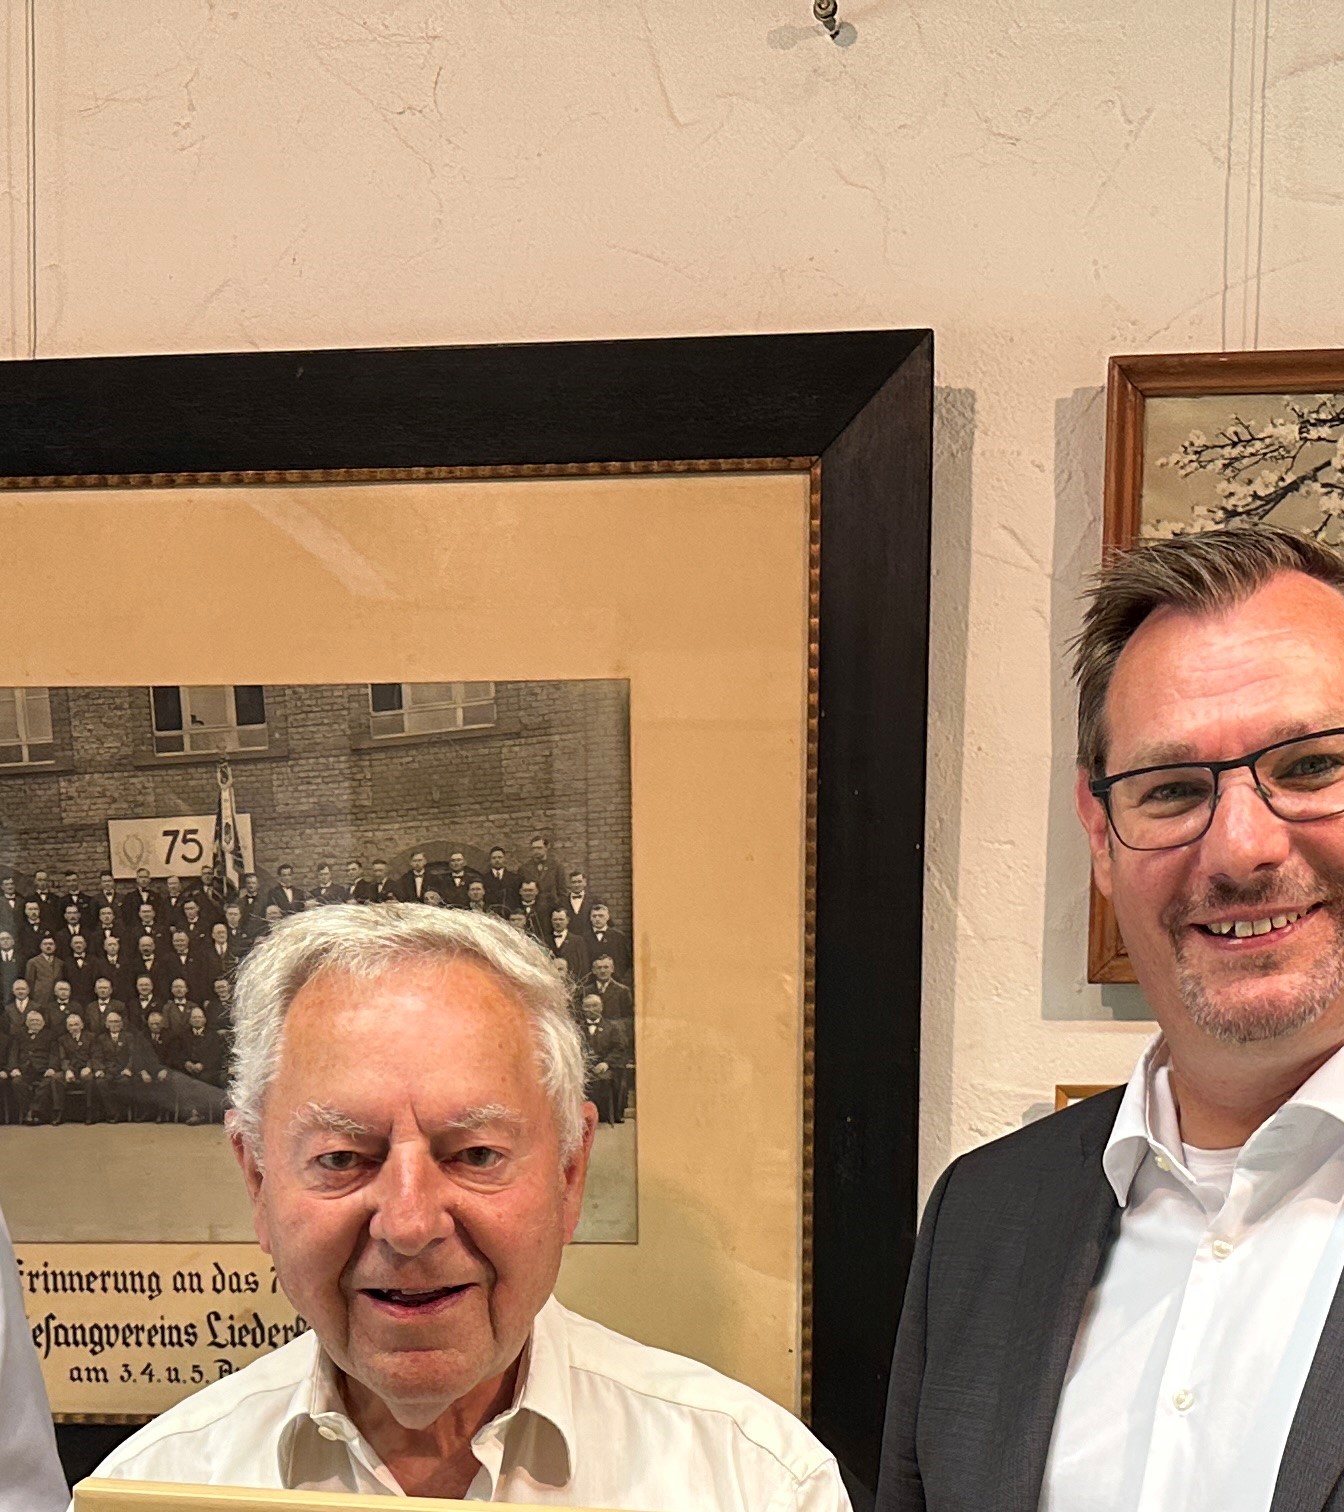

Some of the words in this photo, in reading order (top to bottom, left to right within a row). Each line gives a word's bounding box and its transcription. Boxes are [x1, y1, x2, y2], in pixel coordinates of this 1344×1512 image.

[163, 829, 203, 864] 75
[17, 1259, 163, 1300] rinnerung
[172, 1269, 204, 1294] an
[211, 1262, 259, 1294] das
[69, 1365, 109, 1384] am
